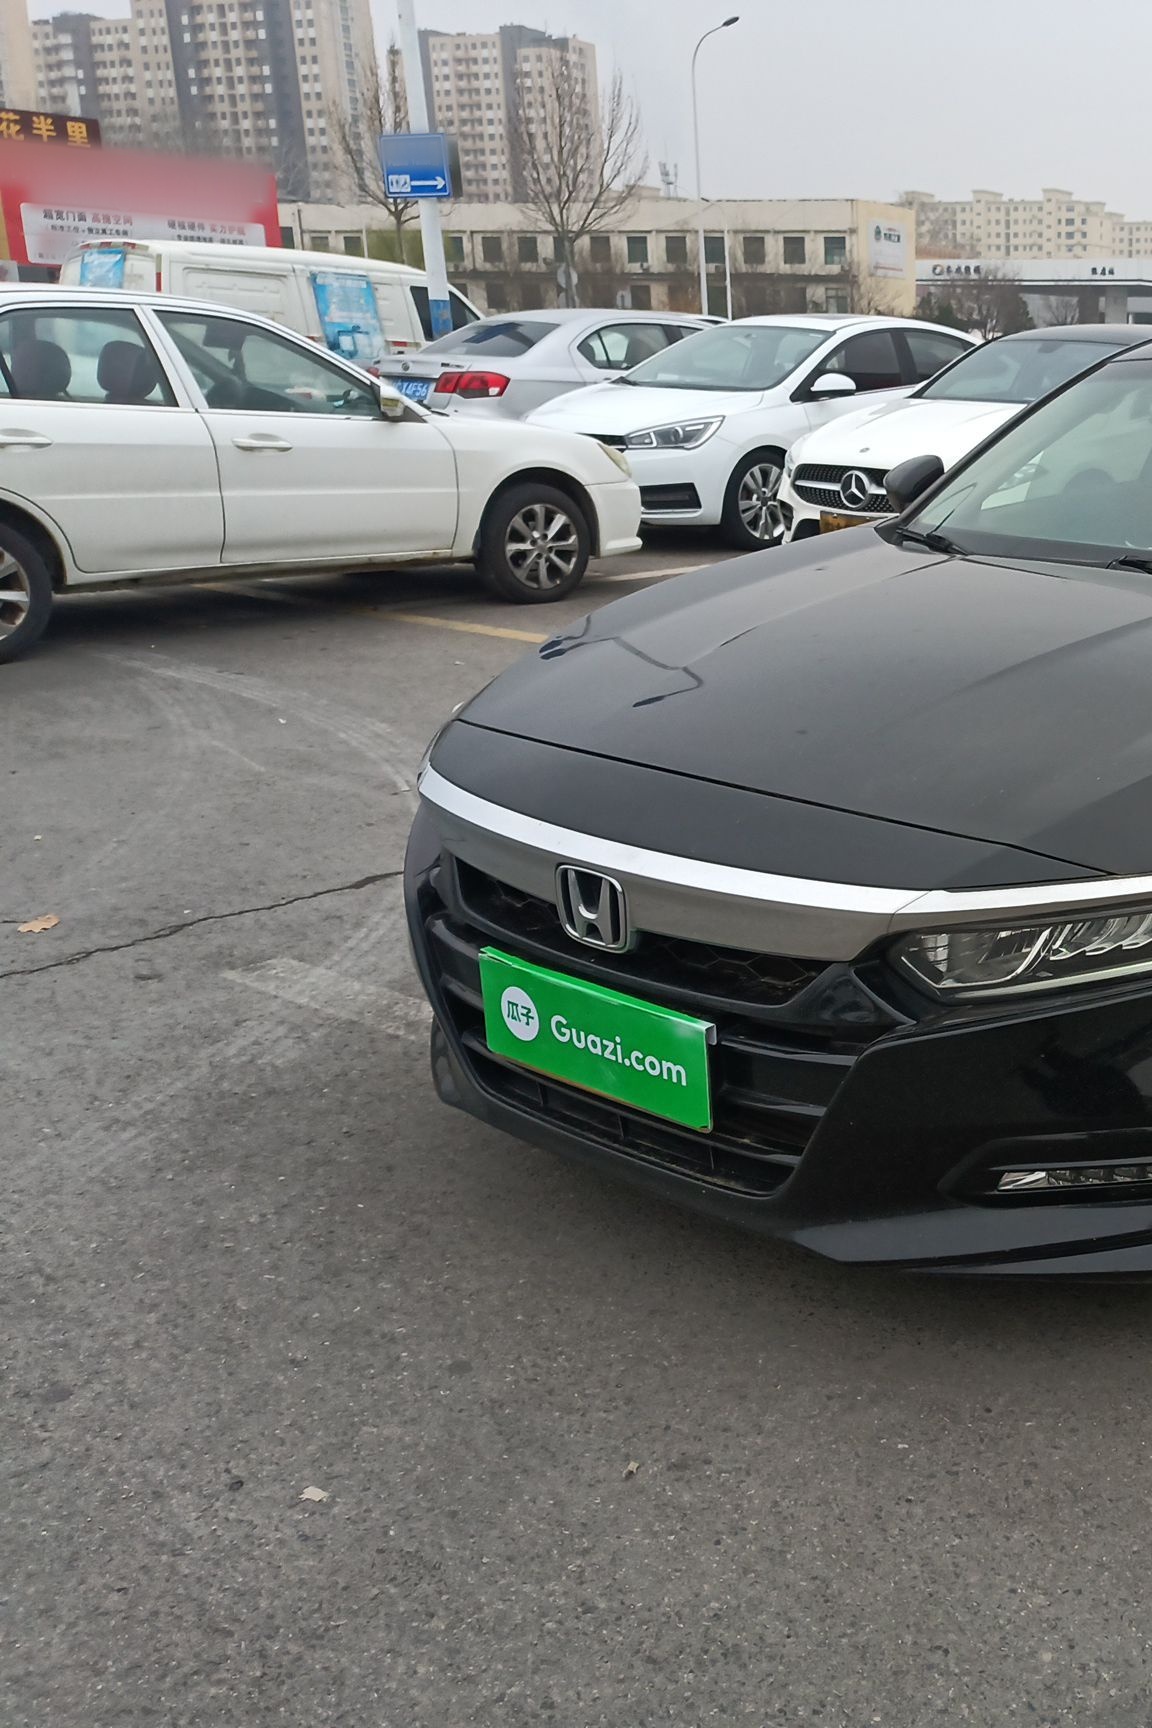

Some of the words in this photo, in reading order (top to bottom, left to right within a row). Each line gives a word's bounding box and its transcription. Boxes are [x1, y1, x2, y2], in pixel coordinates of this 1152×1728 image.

[0, 111, 91, 148] 花半里
[506, 1000, 535, 1026] 瓜子
[550, 1014, 687, 1087] Guazi.com
